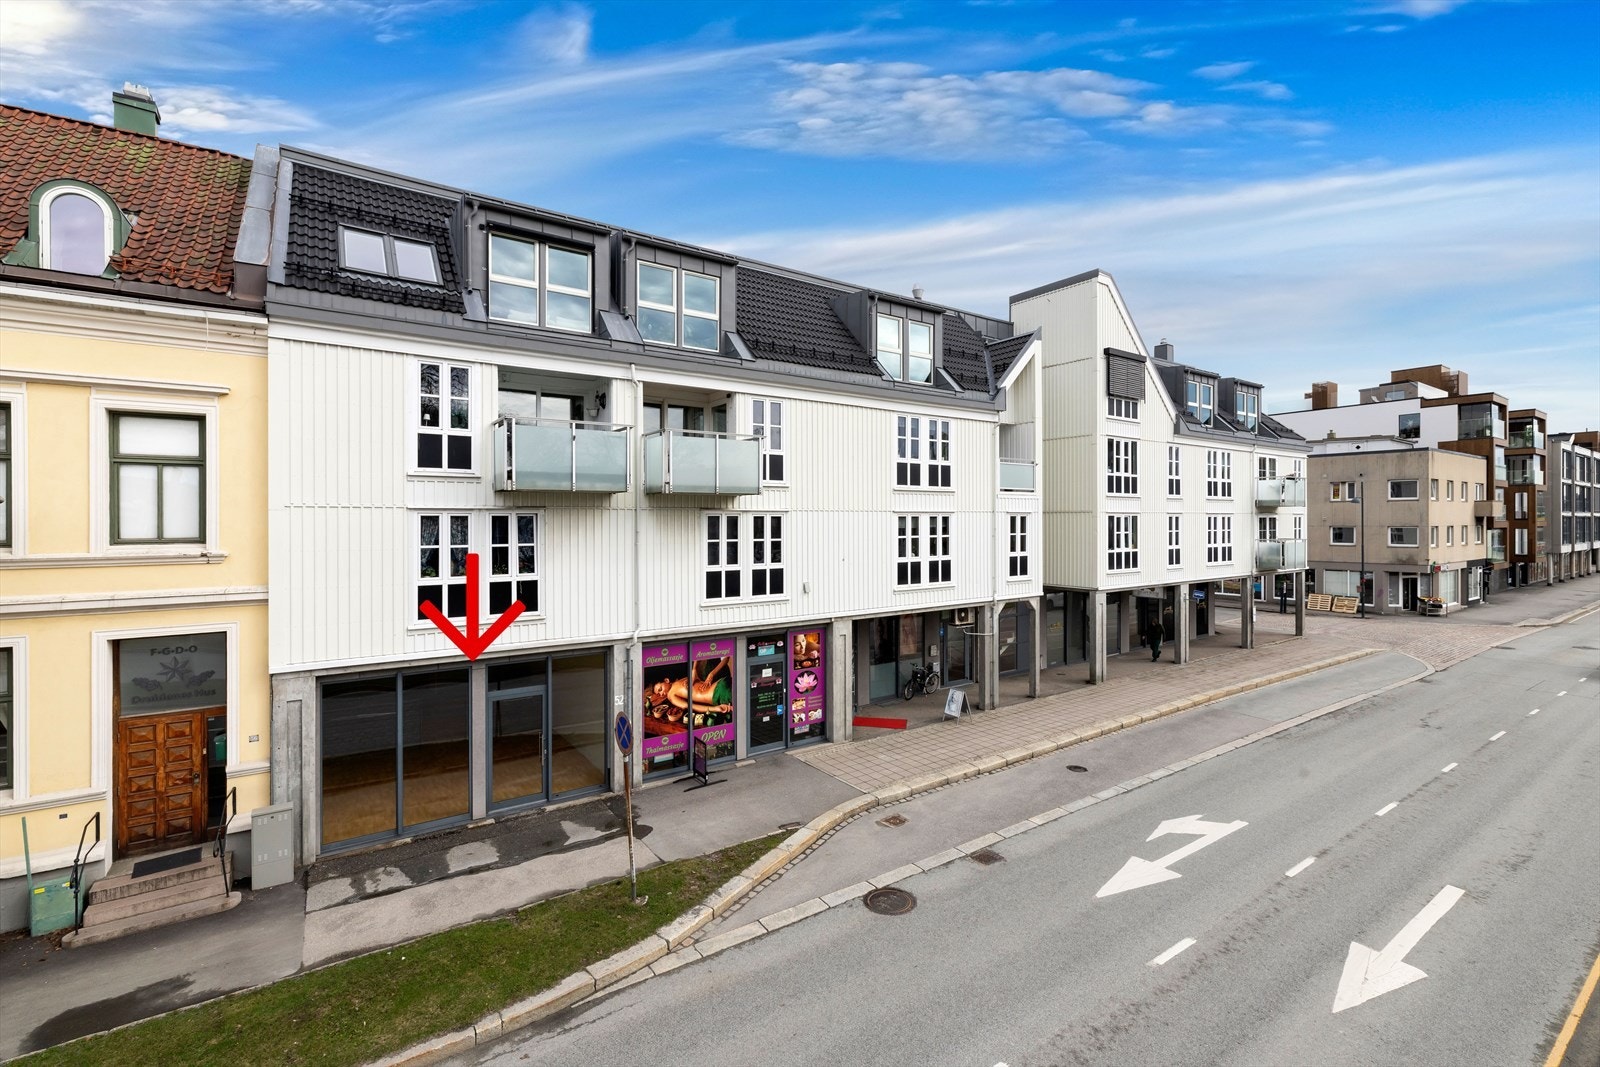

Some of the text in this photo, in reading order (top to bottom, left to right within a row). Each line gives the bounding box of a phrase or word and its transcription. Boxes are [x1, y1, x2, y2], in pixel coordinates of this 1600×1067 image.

[696, 648, 730, 657] Aromaterapi
[646, 654, 683, 664] Oljemassasje
[614, 694, 624, 706] 52
[701, 728, 727, 742] OPEN
